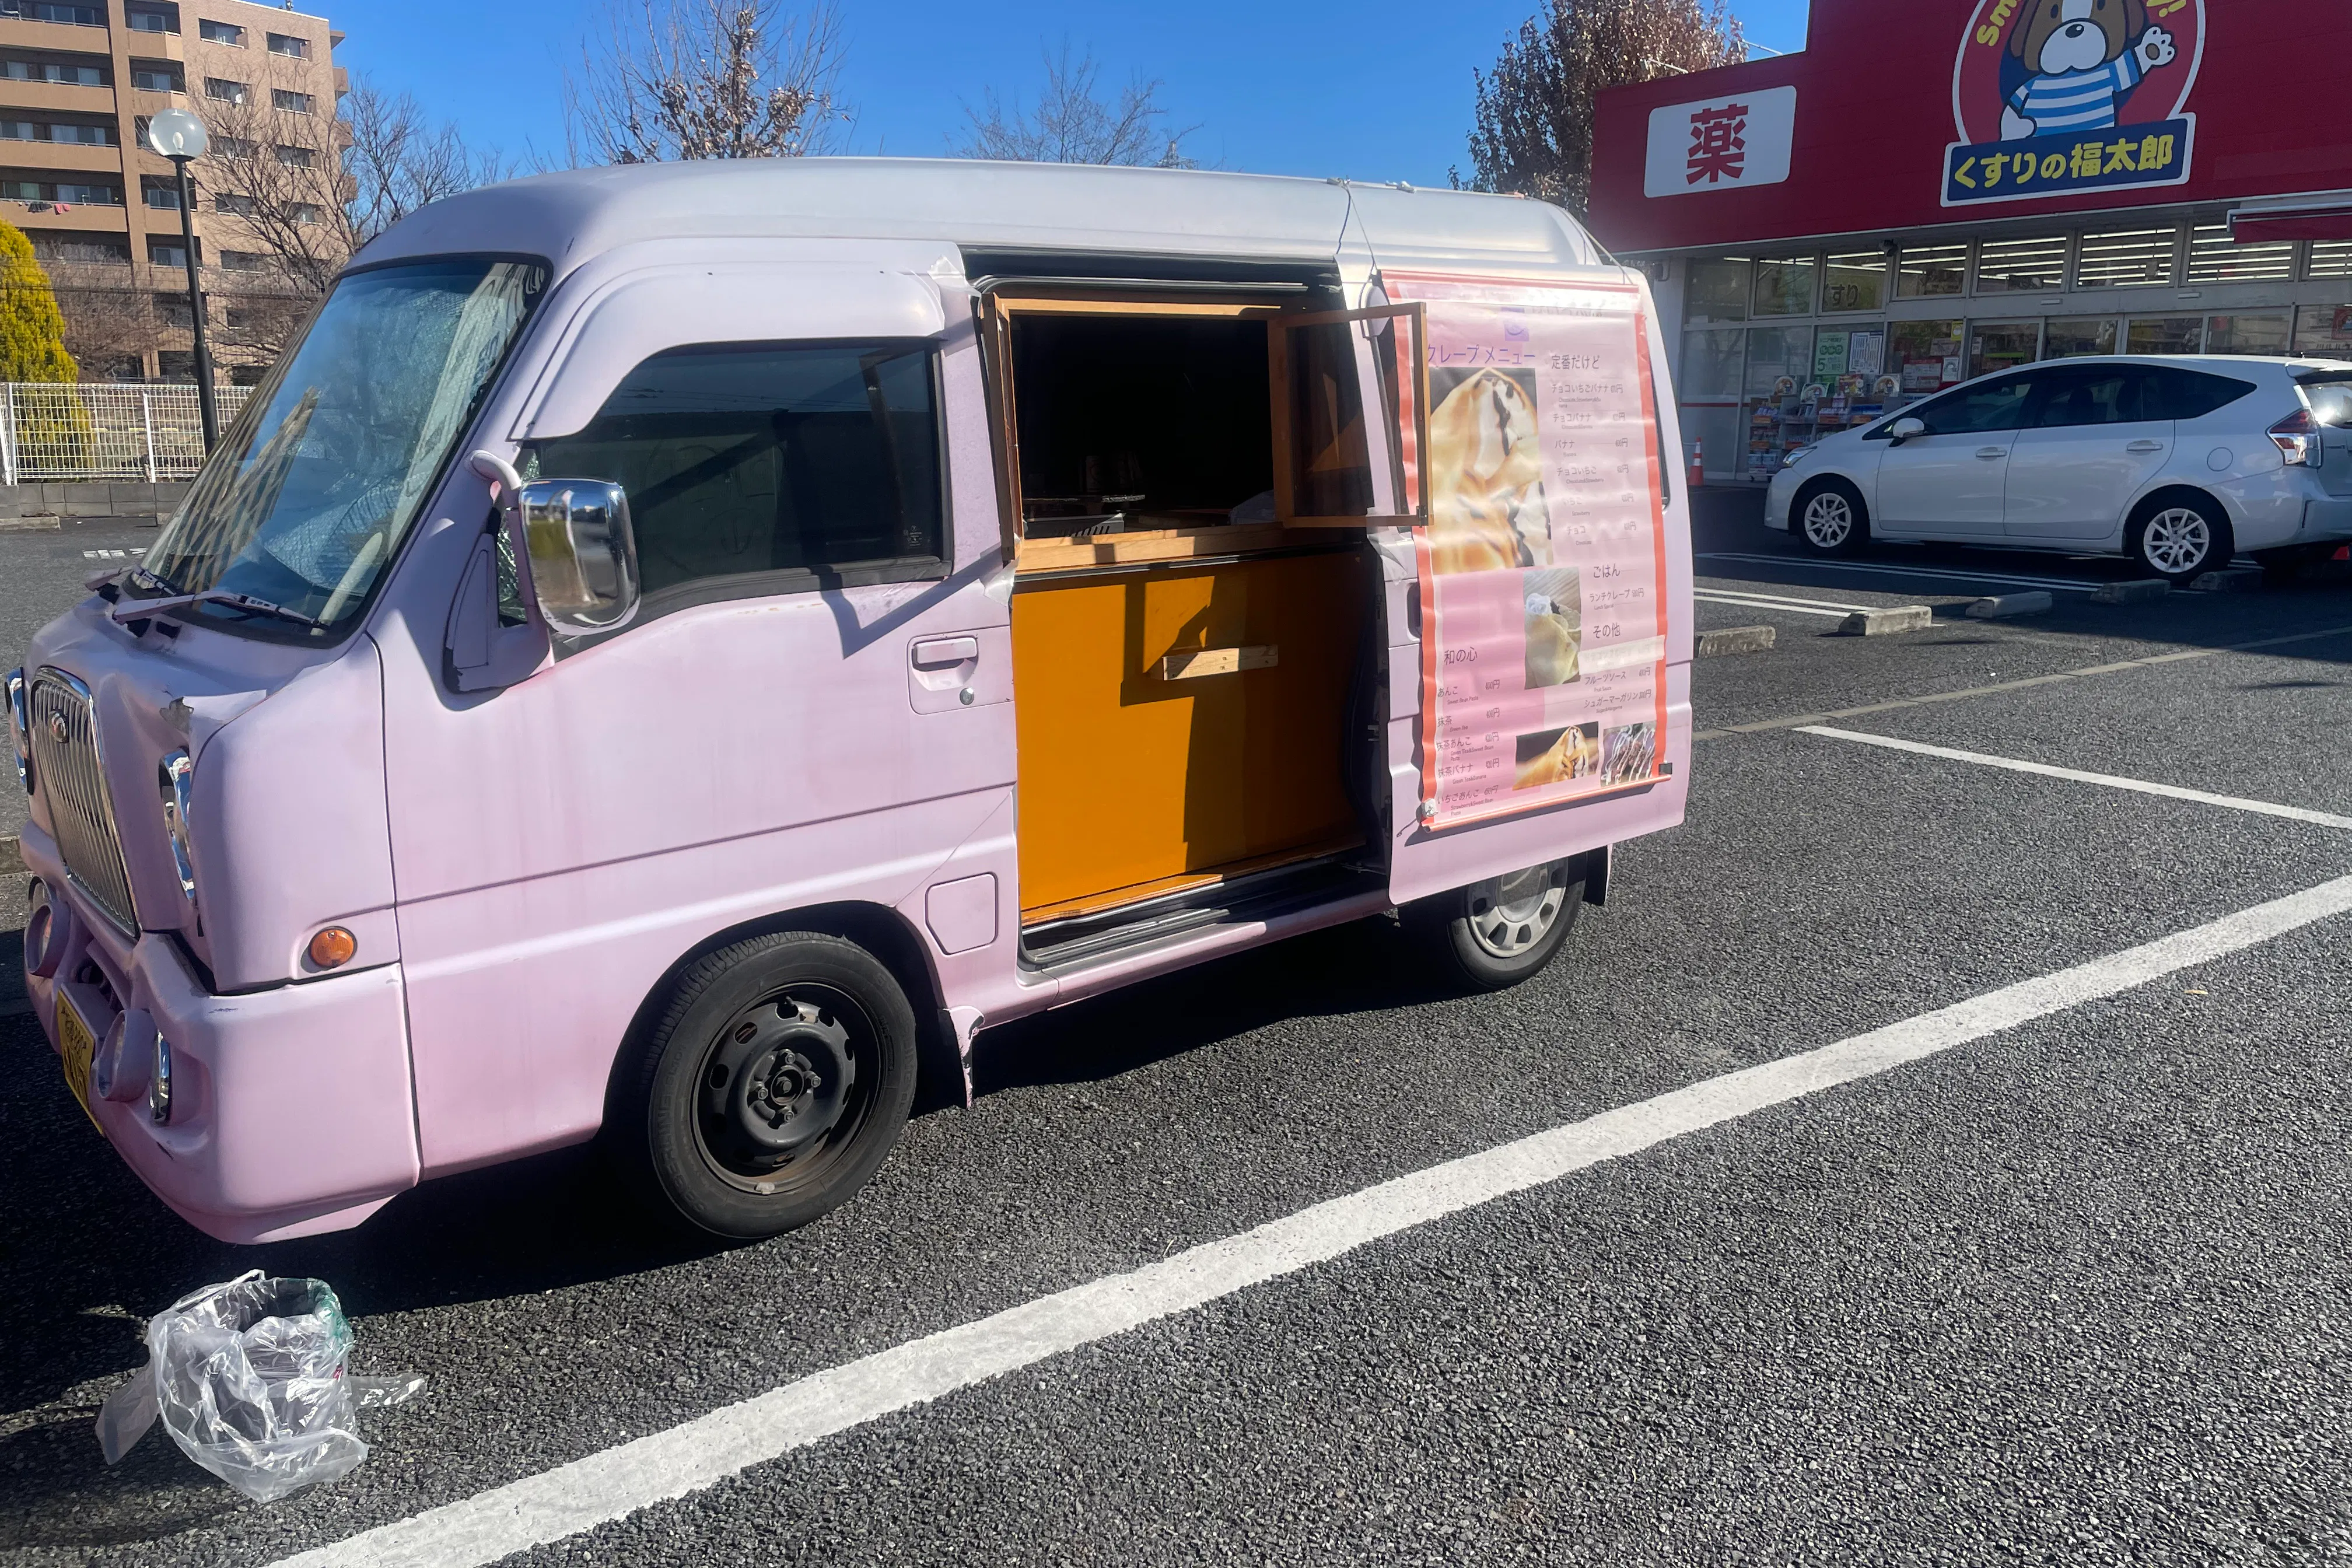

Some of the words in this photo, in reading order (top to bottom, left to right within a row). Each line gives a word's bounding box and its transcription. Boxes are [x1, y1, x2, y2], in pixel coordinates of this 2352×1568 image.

[1686, 103, 1749, 186] 薬
[1954, 134, 2174, 188] くすりの福太郎
[1551, 354, 1600, 370] 定番だけど
[1552, 383, 1609, 394] チョコいちごバナナ
[1553, 412, 1592, 423] チョコバナナ
[1555, 439, 1575, 449] バナナ
[1566, 525, 1586, 536] チョコ
[1593, 563, 1620, 578] ごはん
[1589, 588, 1630, 602] ランチクレープ
[1593, 622, 1620, 639] その他
[1444, 646, 1478, 666] 和の心
[1585, 671, 1626, 685] フルーツソース
[1437, 686, 1458, 698] あんこ
[1584, 692, 1639, 708] シュガーマーガリン
[1437, 715, 1452, 727] 抹茶
[1436, 736, 1471, 752] 抹茶あんこ
[1437, 762, 1474, 779] 抹茶バナナ
[1437, 789, 1479, 804] いちごあんこ
